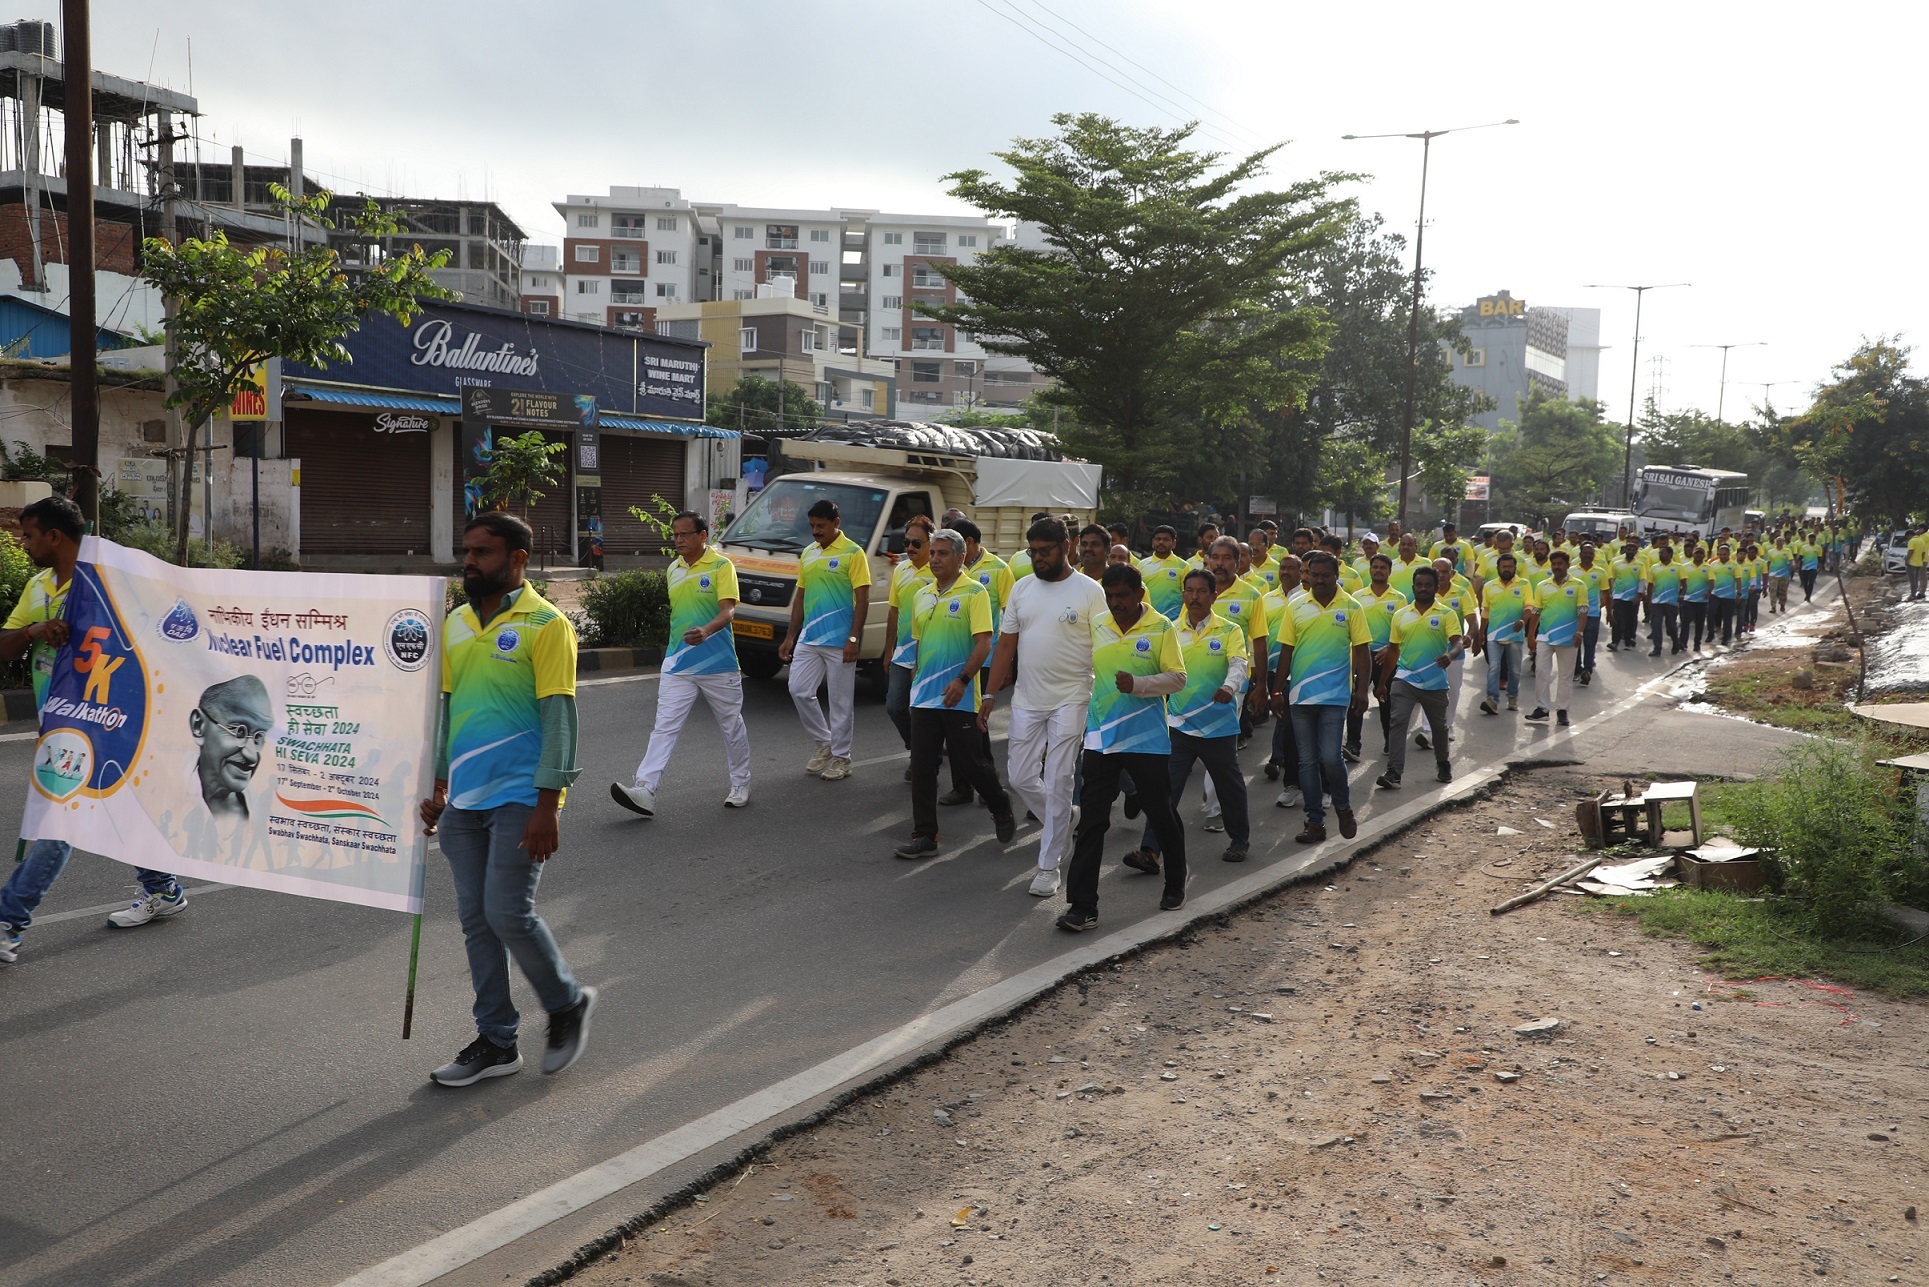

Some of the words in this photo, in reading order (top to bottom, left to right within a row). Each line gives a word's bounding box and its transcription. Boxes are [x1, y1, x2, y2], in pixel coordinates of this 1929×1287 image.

[1480, 300, 1524, 317] BAR
[410, 319, 539, 377] Ballantine's
[643, 356, 659, 367] SRI
[660, 358, 699, 372] MARUTHI
[646, 369, 671, 381] WINE
[671, 372, 696, 384] MART
[232, 385, 265, 416] WINES
[525, 399, 557, 410] FLAVOUR
[526, 408, 549, 418] NOTES
[373, 412, 429, 434] Signature
[1643, 472, 1660, 483] SRI
[1658, 473, 1675, 486] SAI
[1674, 475, 1712, 490] GANESH
[208, 605, 254, 628] नाभिकीय
[296, 608, 349, 631] सम्मिश्र
[205, 627, 252, 658] Nuclear
[253, 635, 287, 662] Fuel
[289, 636, 376, 672] Complex
[400, 651, 419, 659] NFC
[44, 695, 128, 731] Walkathon
[285, 704, 339, 719] स्वच्छता
[286, 718, 299, 735] ही
[302, 719, 328, 736] सेवा
[332, 721, 361, 735] 2024
[277, 736, 353, 755] SWACHHATA
[275, 746, 287, 759] HI
[290, 749, 320, 765] SEVA
[323, 754, 357, 768] 2024
[276, 763, 286, 772] 17
[319, 771, 326, 780] 2
[358, 776, 380, 787] 2024
[289, 779, 322, 792] September
[336, 787, 361, 798] October
[362, 790, 380, 800] 2024
[268, 826, 295, 839] Swabhav
[295, 831, 331, 846] Swachhata,
[331, 837, 361, 850] Sanskaar
[361, 840, 397, 855] Swachhata
[362, 830, 397, 843] स्वच्छता
